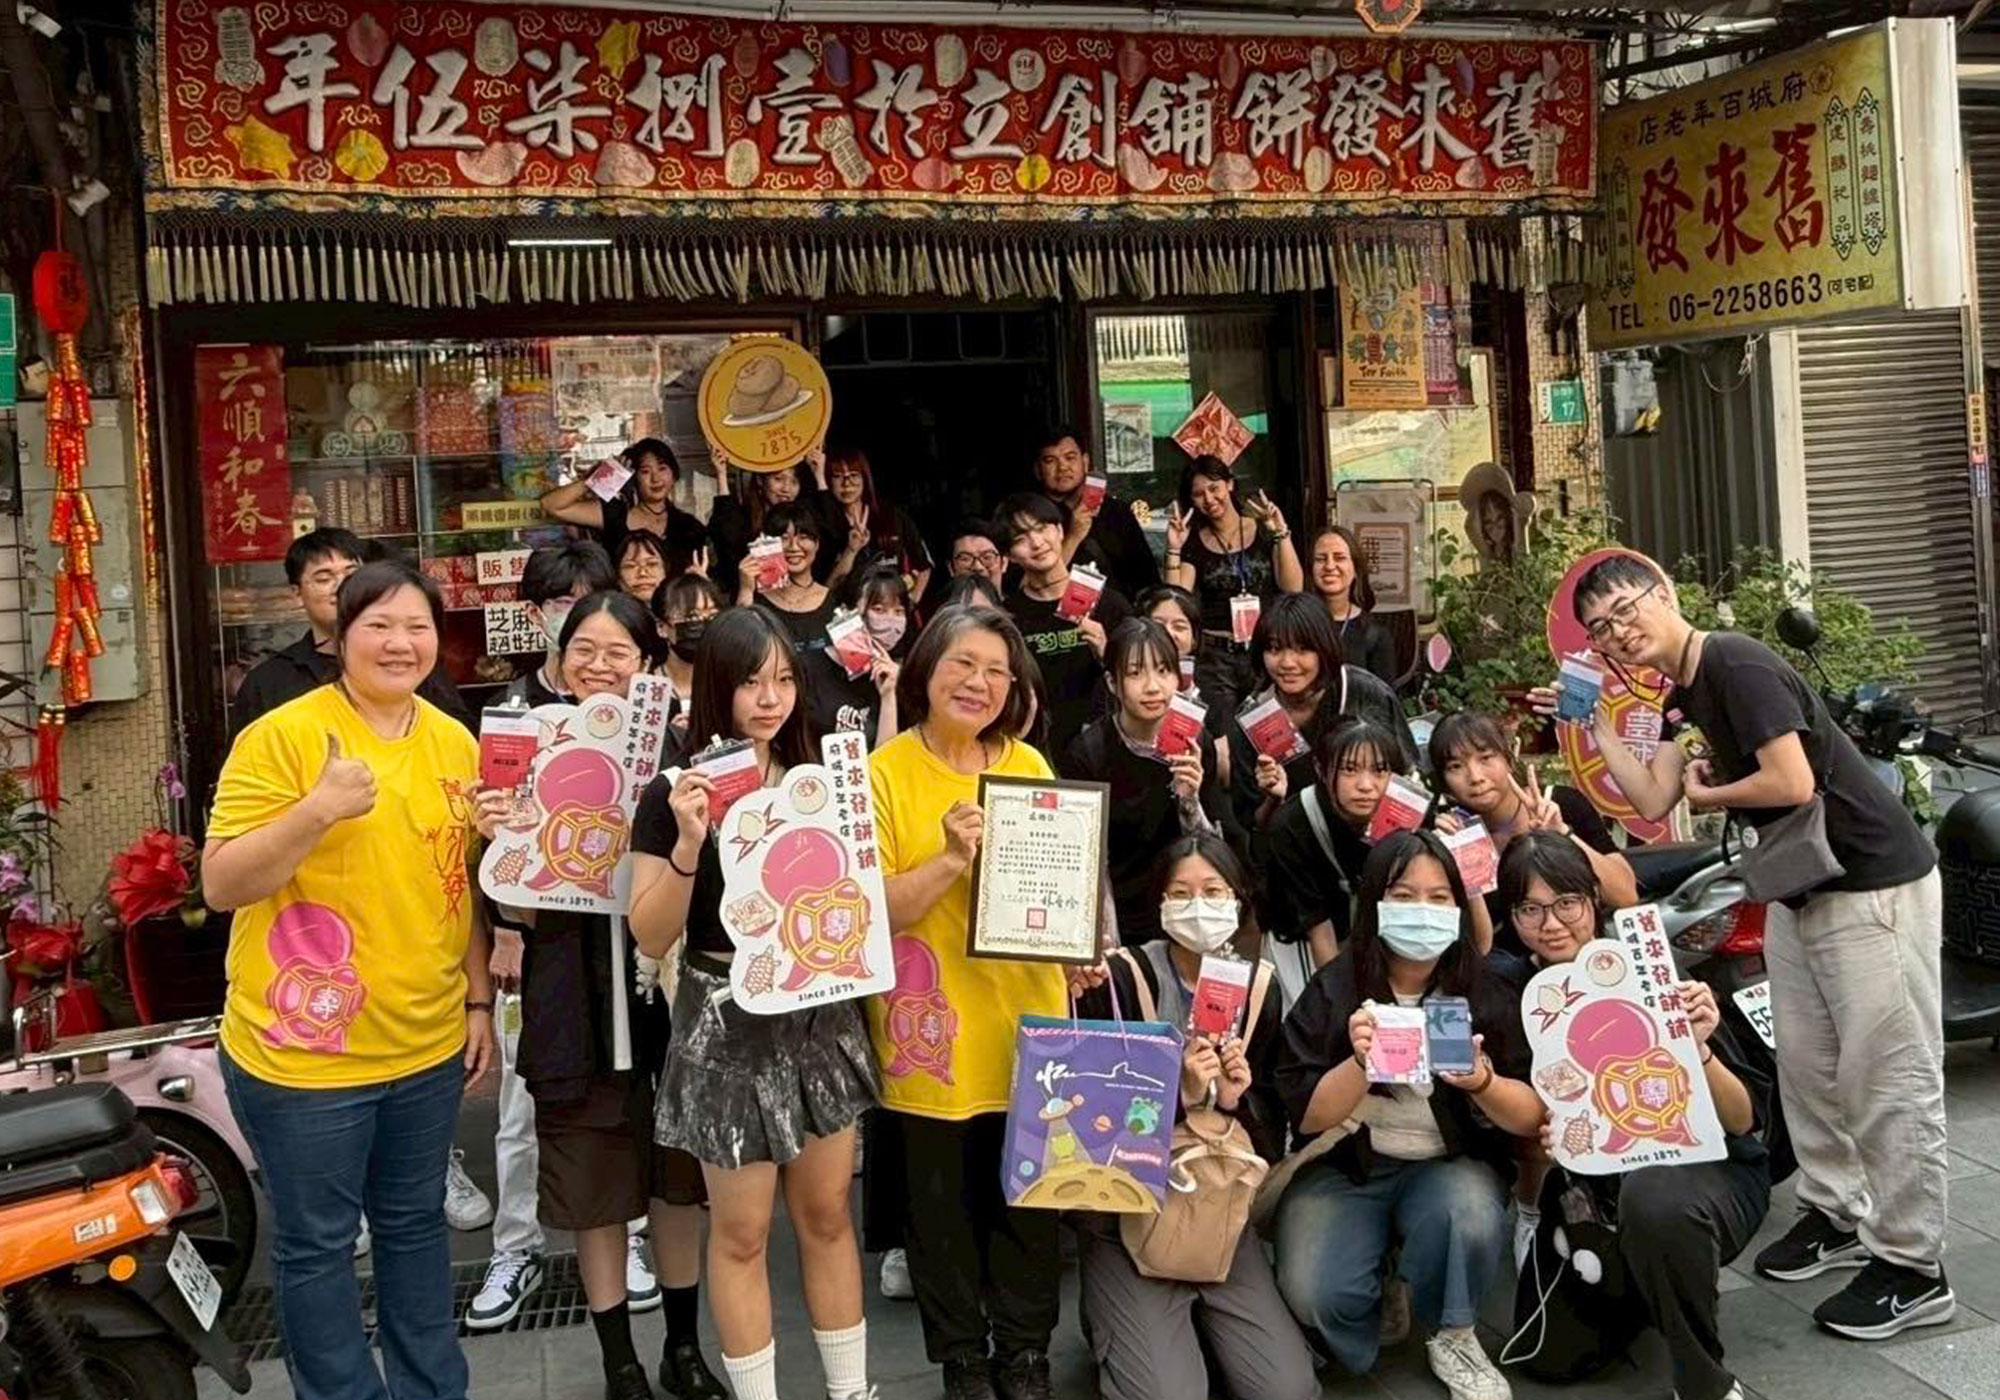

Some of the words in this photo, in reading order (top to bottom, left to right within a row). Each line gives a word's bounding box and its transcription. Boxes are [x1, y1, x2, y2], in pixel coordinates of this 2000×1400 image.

[1637, 71, 1807, 146] 府城百年老店
[1636, 122, 1824, 275] 舊來發
[1669, 273, 1823, 323] 06-2258663
[1562, 401, 1576, 417] 17
[760, 431, 802, 457] 1875
[1654, 1149, 1682, 1162] 1875
